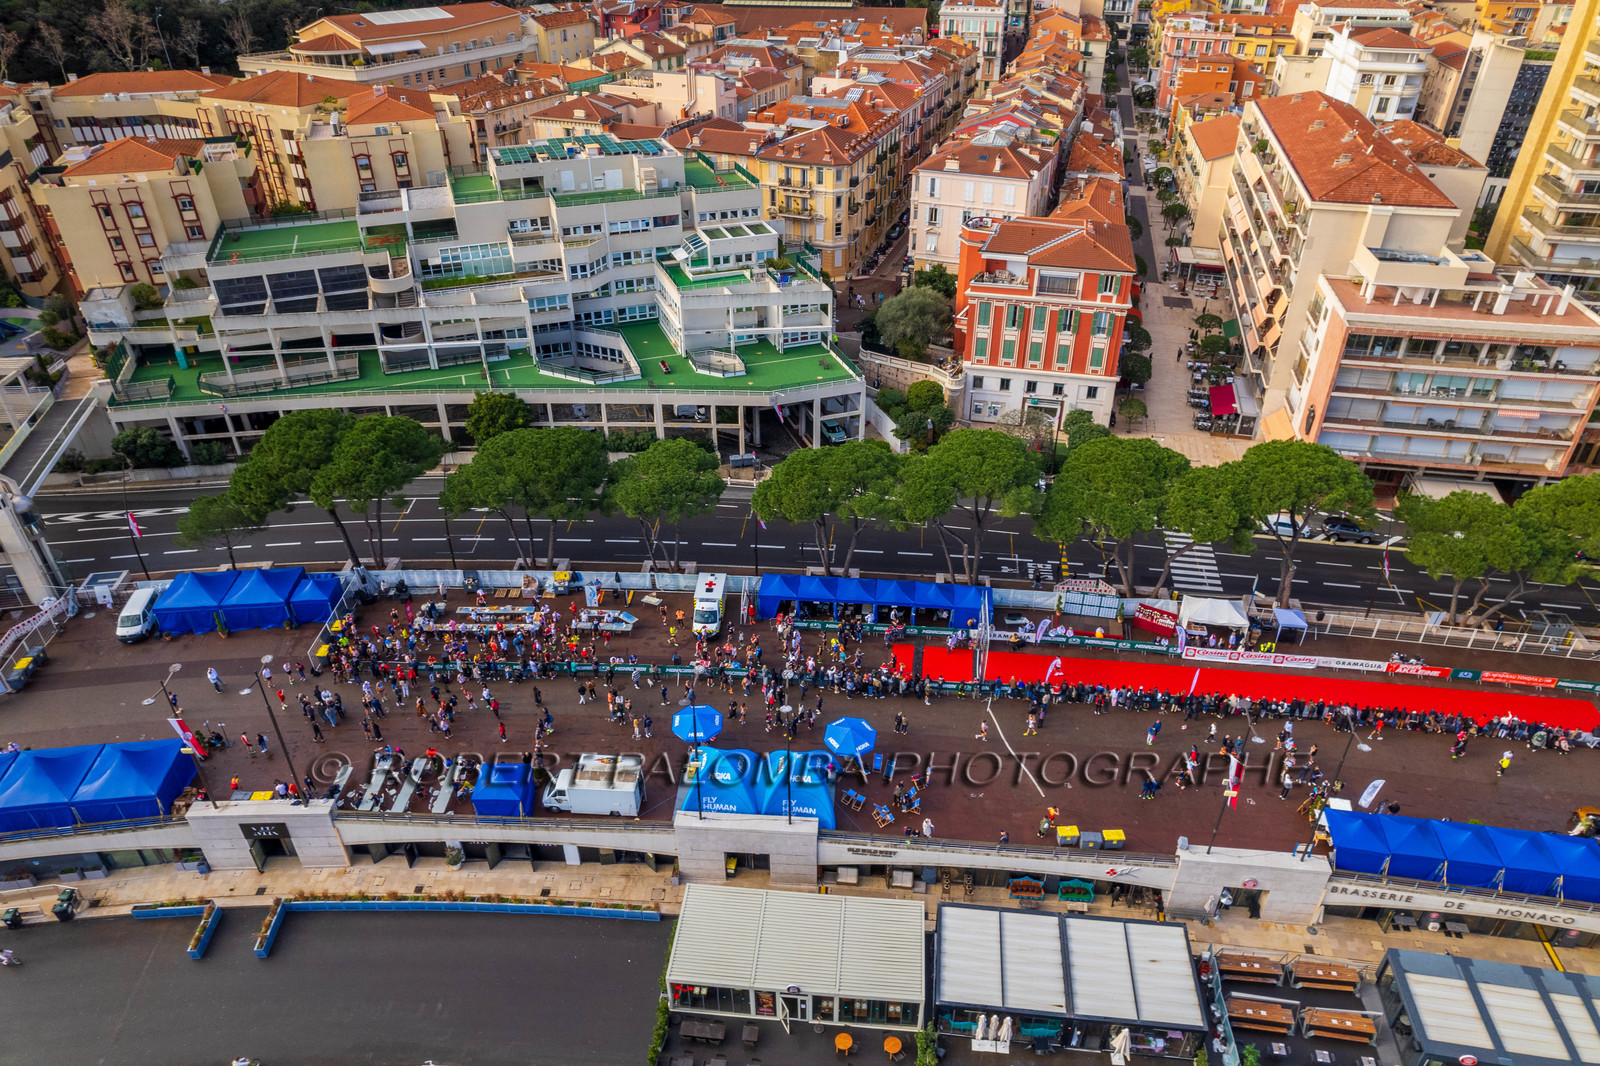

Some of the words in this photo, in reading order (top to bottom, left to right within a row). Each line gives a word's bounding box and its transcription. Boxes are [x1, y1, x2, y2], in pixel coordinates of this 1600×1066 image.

[1196, 648, 1228, 656] Casino
[1241, 652, 1273, 660] Casino
[1335, 660, 1382, 669] GRAMAGLIA
[827, 736, 840, 749] HOKA
[855, 741, 870, 752] HOKA
[702, 796, 717, 804] FLY
[702, 803, 737, 812] HUMAN
[1330, 885, 1414, 904] BRASSERIE
[1443, 900, 1466, 910] DE
[1496, 907, 1576, 925] MONACO
